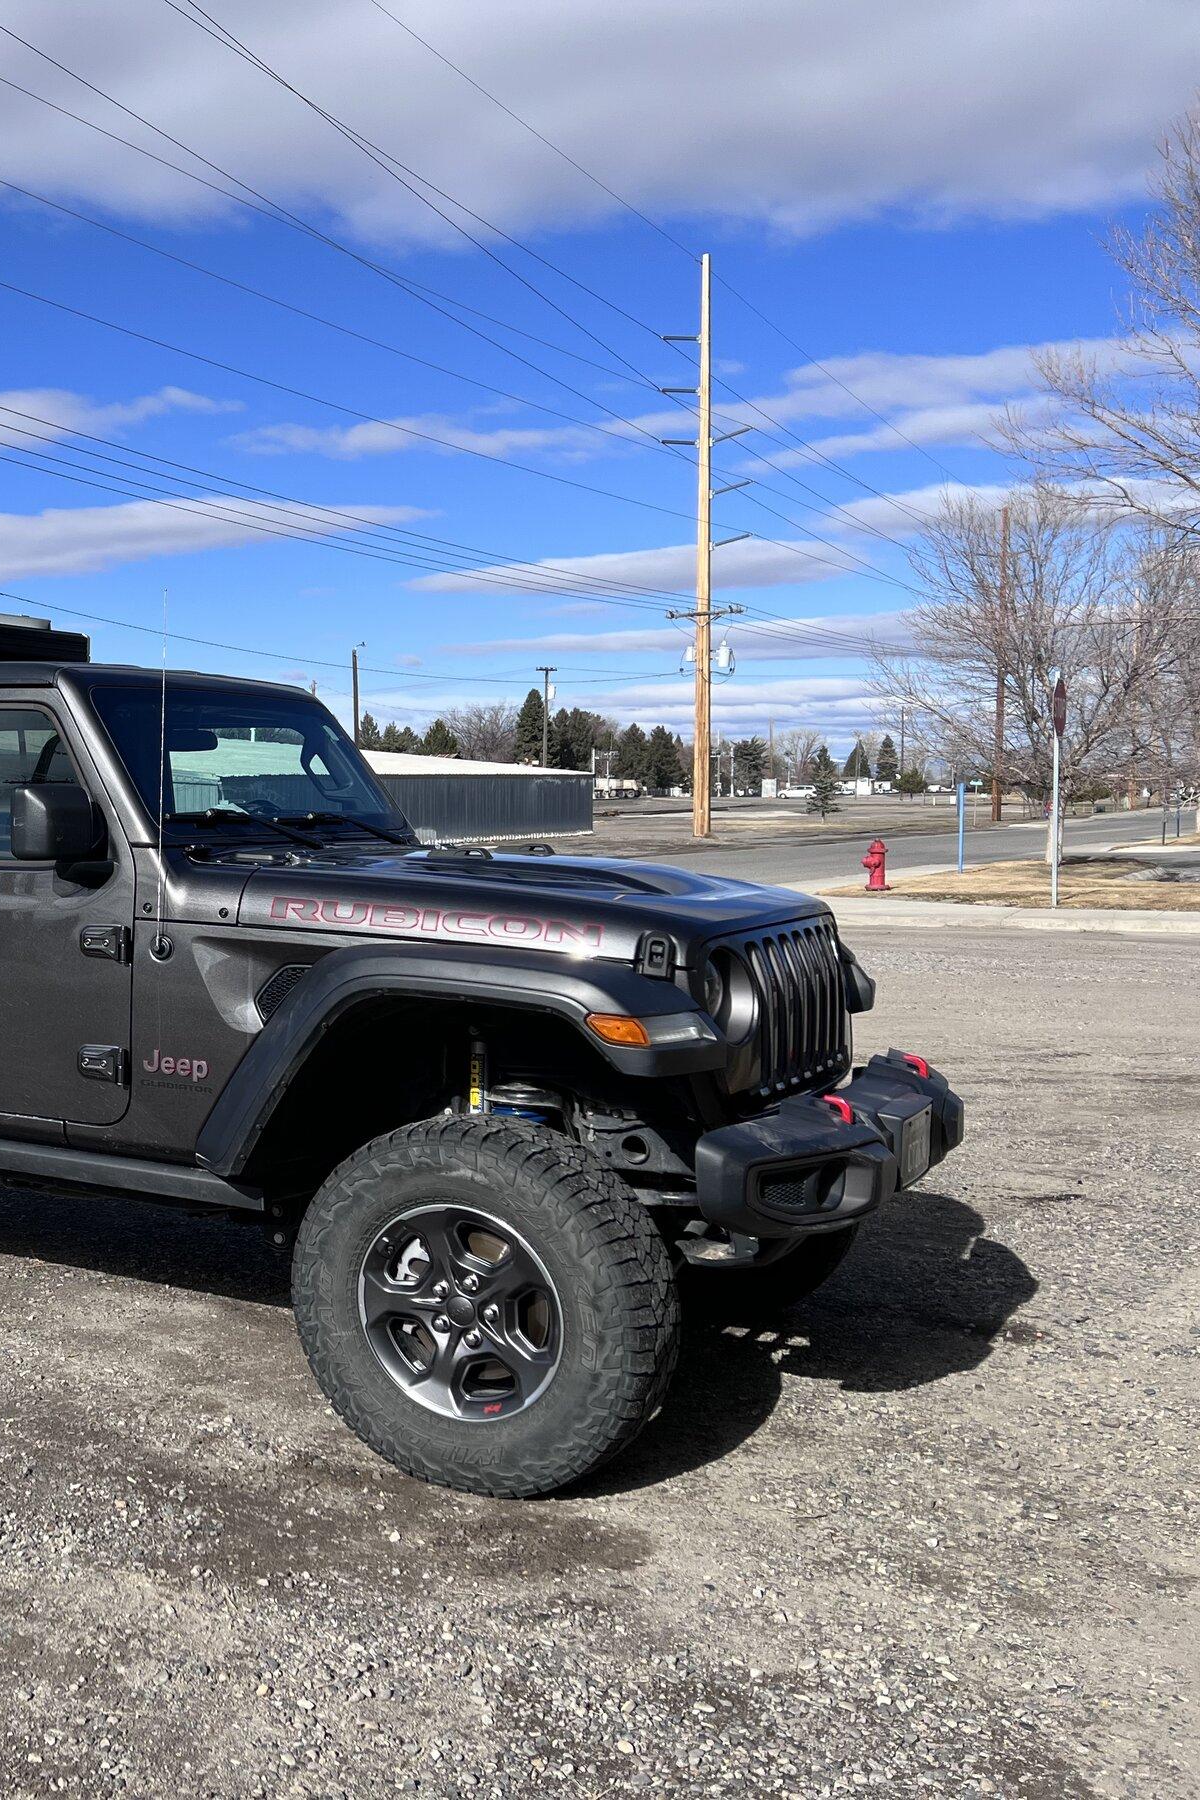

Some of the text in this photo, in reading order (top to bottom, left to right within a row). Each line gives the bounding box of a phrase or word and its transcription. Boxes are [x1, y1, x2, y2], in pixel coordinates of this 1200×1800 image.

[270, 896, 605, 947] RUBICON
[143, 1049, 208, 1082] Jeep
[141, 1079, 213, 1095] GLADIATOR
